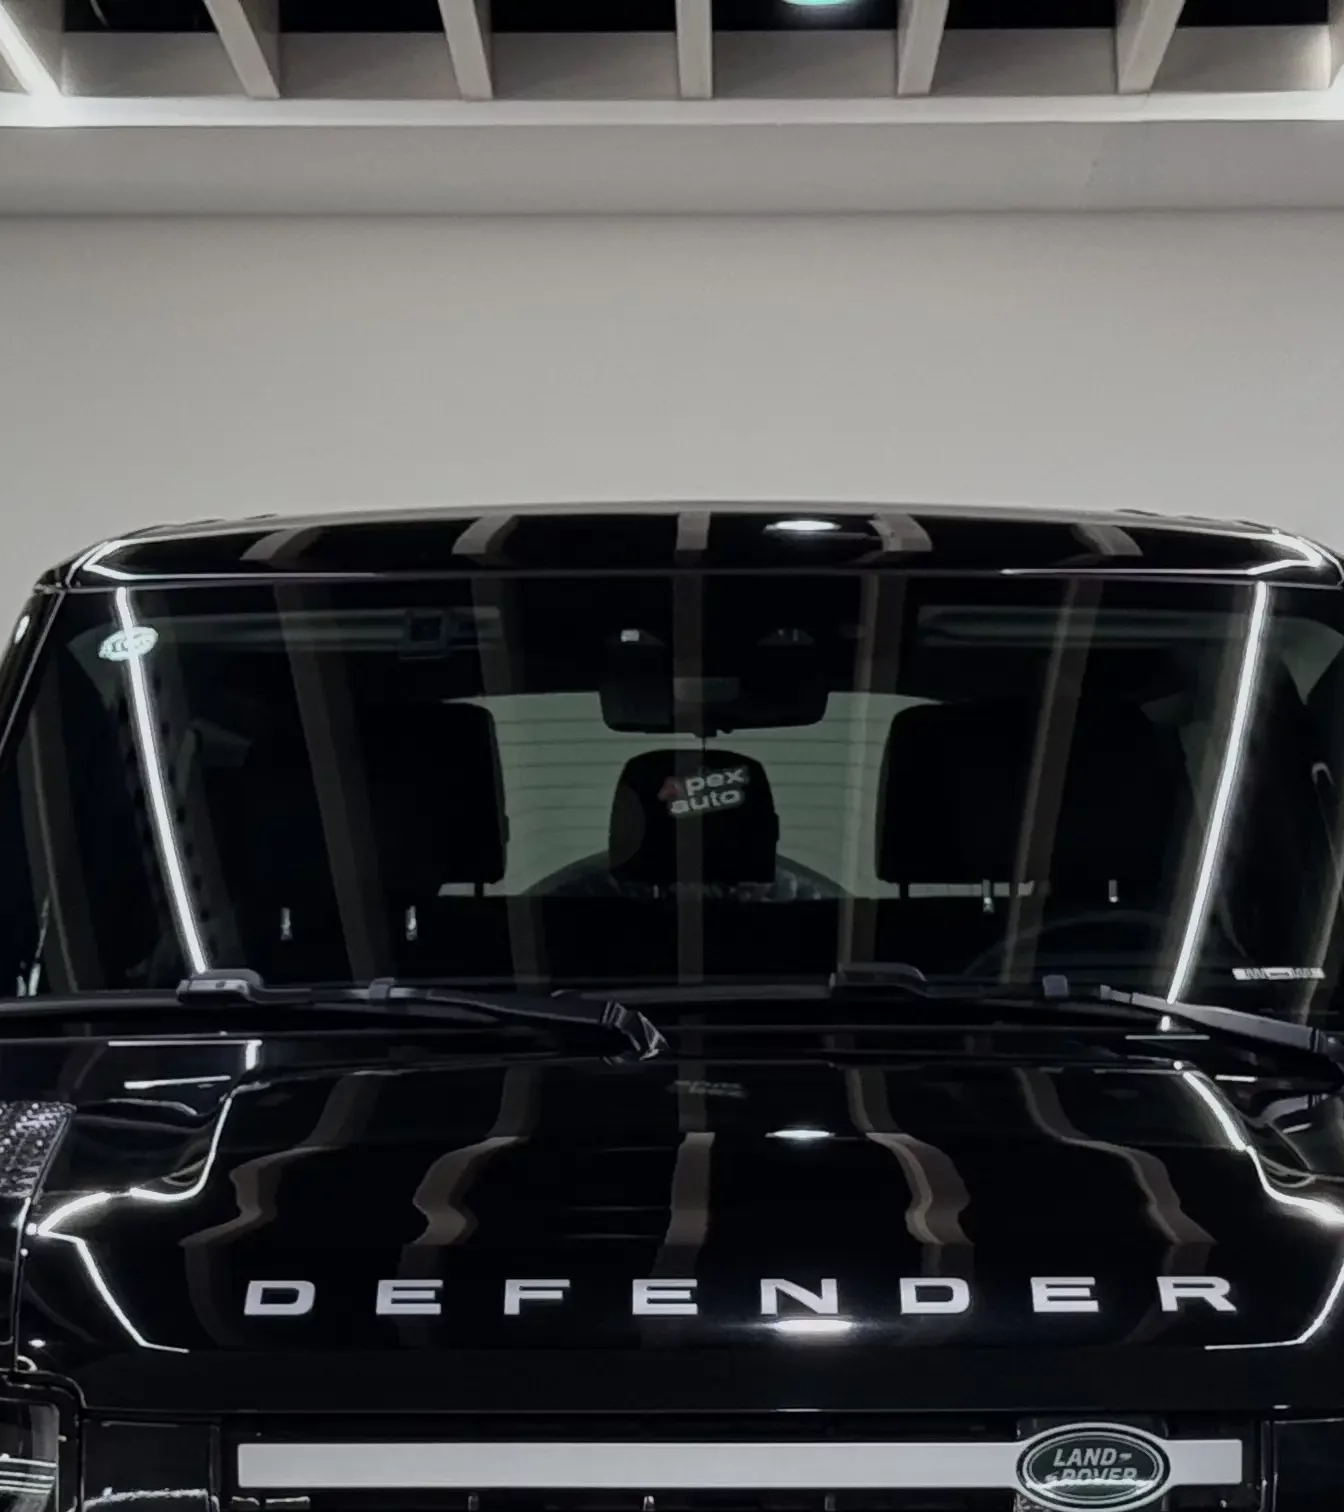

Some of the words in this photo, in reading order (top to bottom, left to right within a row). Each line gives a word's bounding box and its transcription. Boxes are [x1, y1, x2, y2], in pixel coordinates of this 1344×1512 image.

[671, 790, 742, 814] auto
[244, 1276, 1237, 1315] DEFENDER
[1053, 1448, 1118, 1467] LAND
